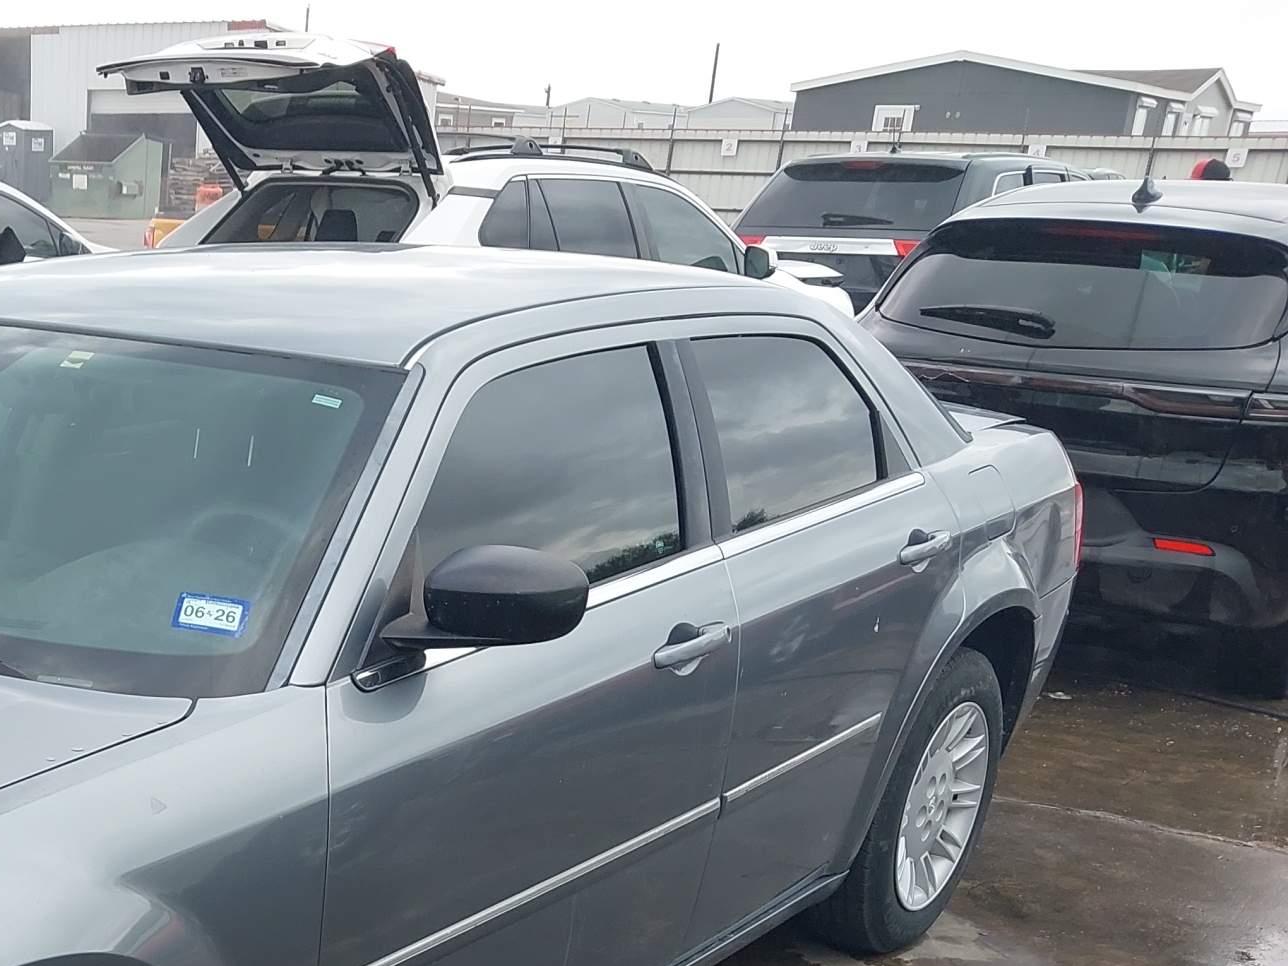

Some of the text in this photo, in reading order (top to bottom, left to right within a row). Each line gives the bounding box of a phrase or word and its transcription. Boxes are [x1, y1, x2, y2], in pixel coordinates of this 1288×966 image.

[809, 241, 838, 253] Jeep
[183, 604, 237, 624] 06 26
